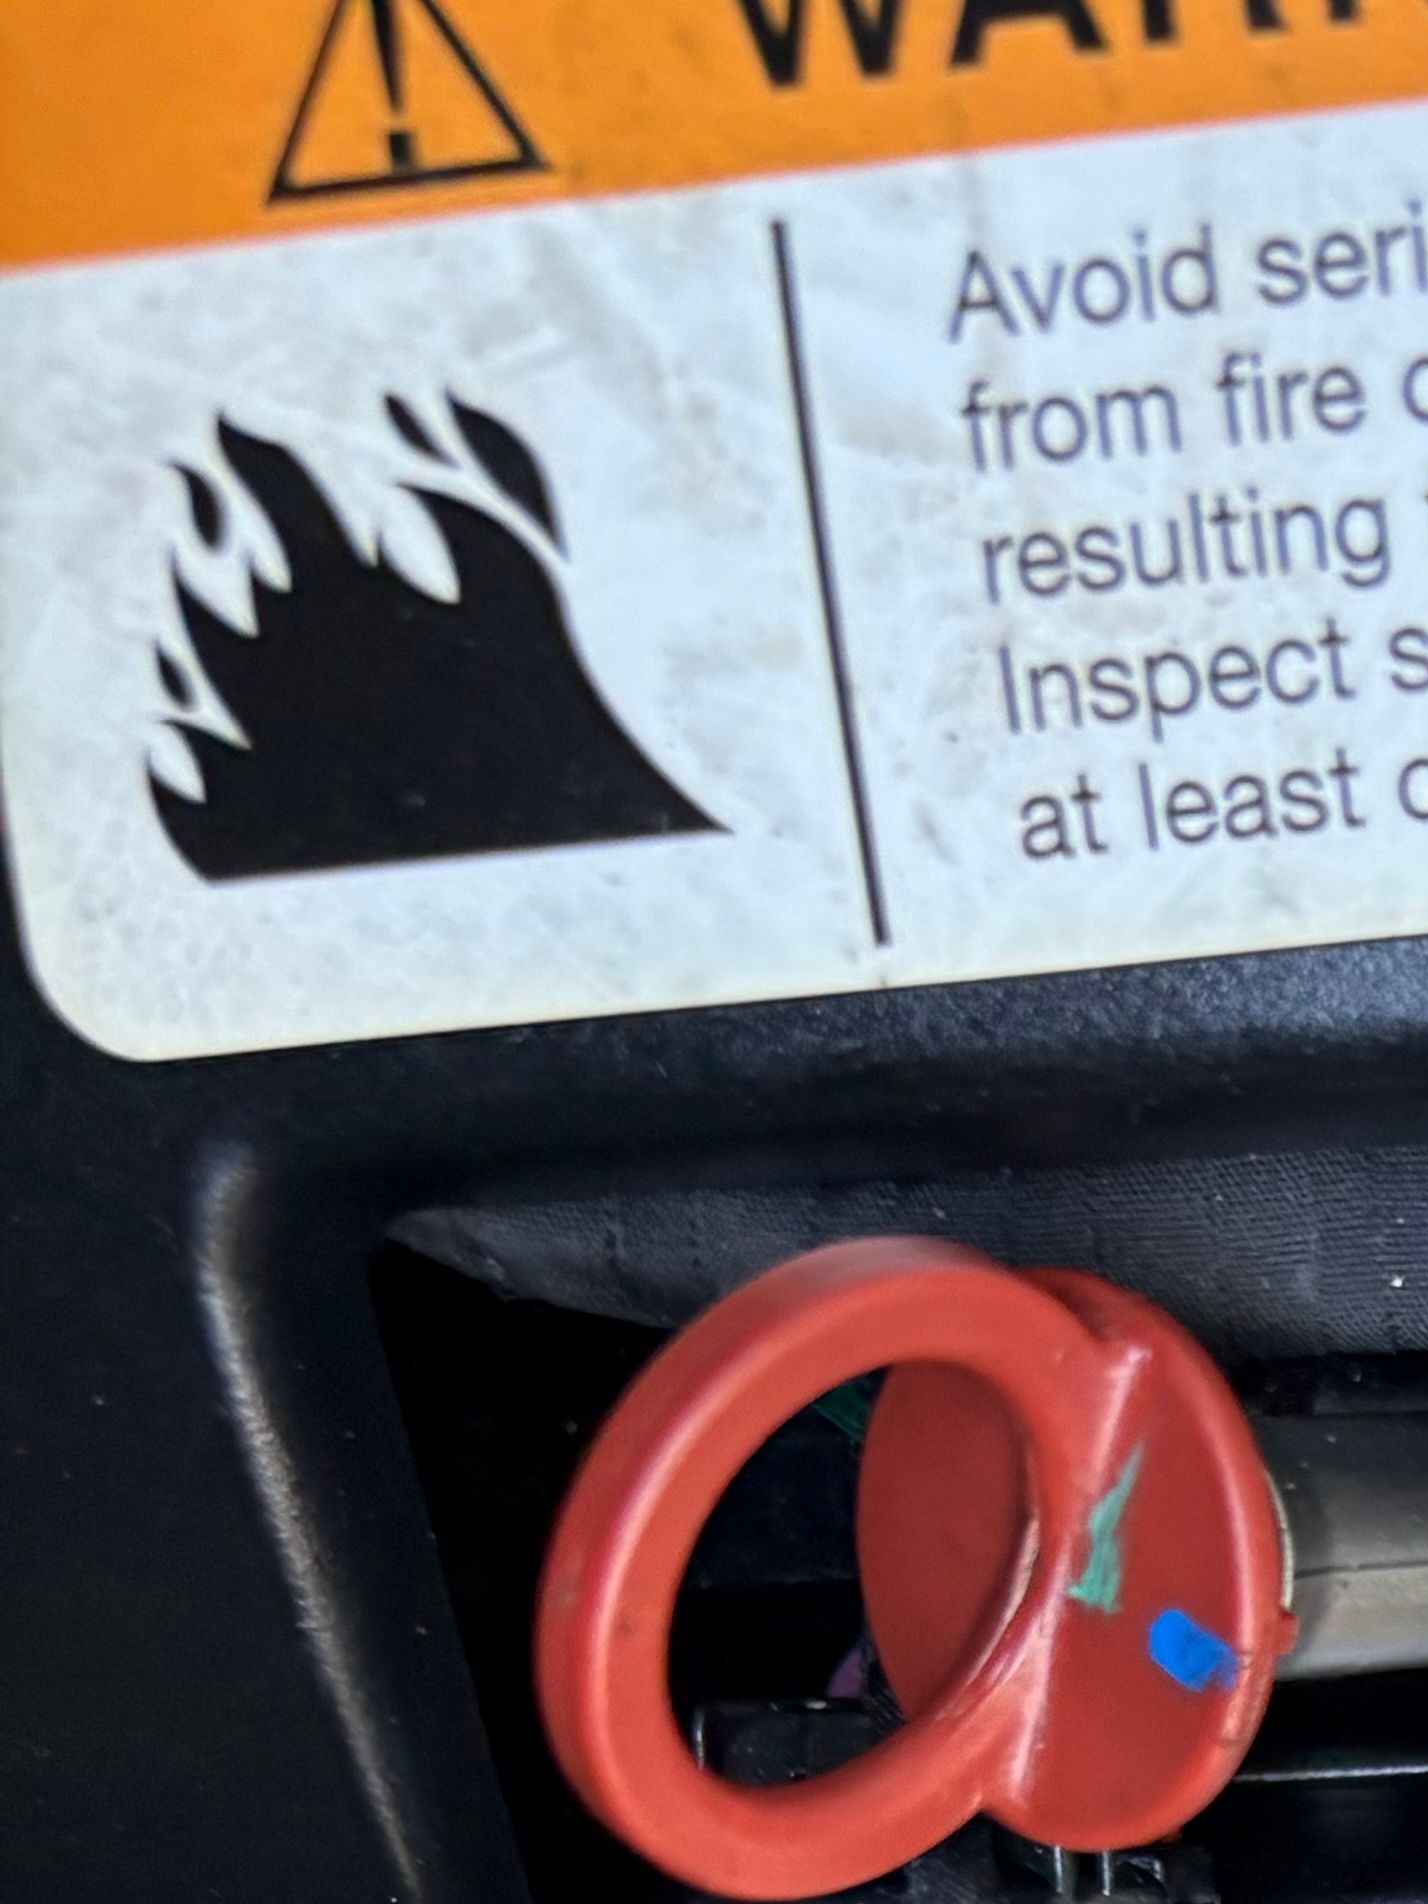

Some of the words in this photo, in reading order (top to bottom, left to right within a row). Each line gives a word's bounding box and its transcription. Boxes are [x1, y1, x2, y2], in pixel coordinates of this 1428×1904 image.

[948, 222, 1219, 343] Avoid
[962, 380, 1182, 473] from
[1216, 352, 1368, 446] fire
[983, 487, 1391, 605] resulting
[999, 617, 1356, 743] Inspect
[1020, 774, 1108, 861] at
[1139, 748, 1366, 851] least
